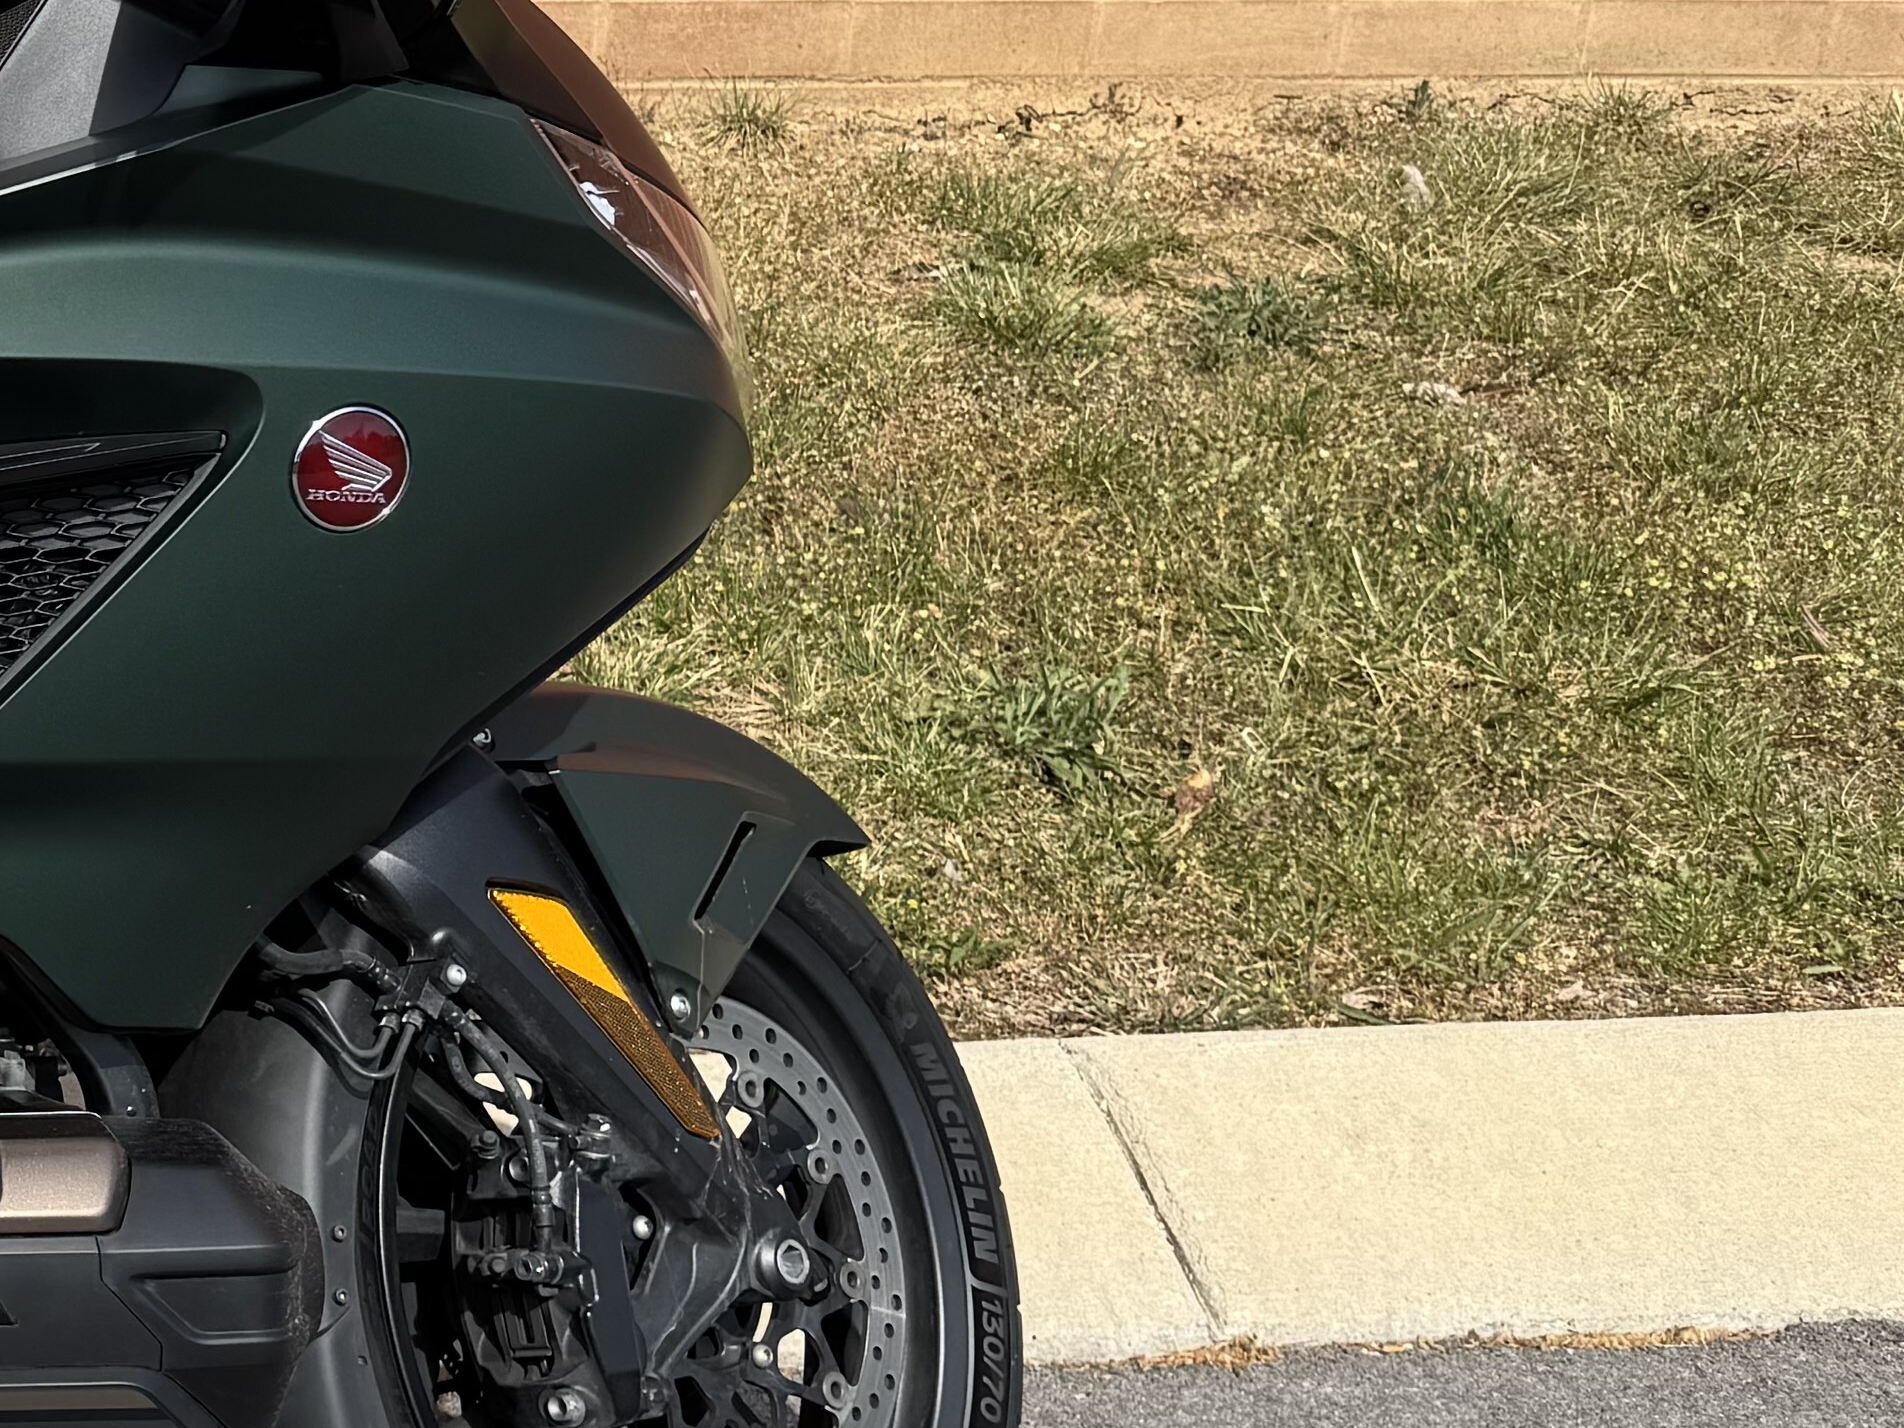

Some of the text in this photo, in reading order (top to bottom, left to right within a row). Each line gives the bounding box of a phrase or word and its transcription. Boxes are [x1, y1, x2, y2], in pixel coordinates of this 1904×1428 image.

[306, 489, 386, 503] HONDA
[909, 1042, 999, 1264] MICHELIN
[981, 1299, 1007, 1424] 130/70
